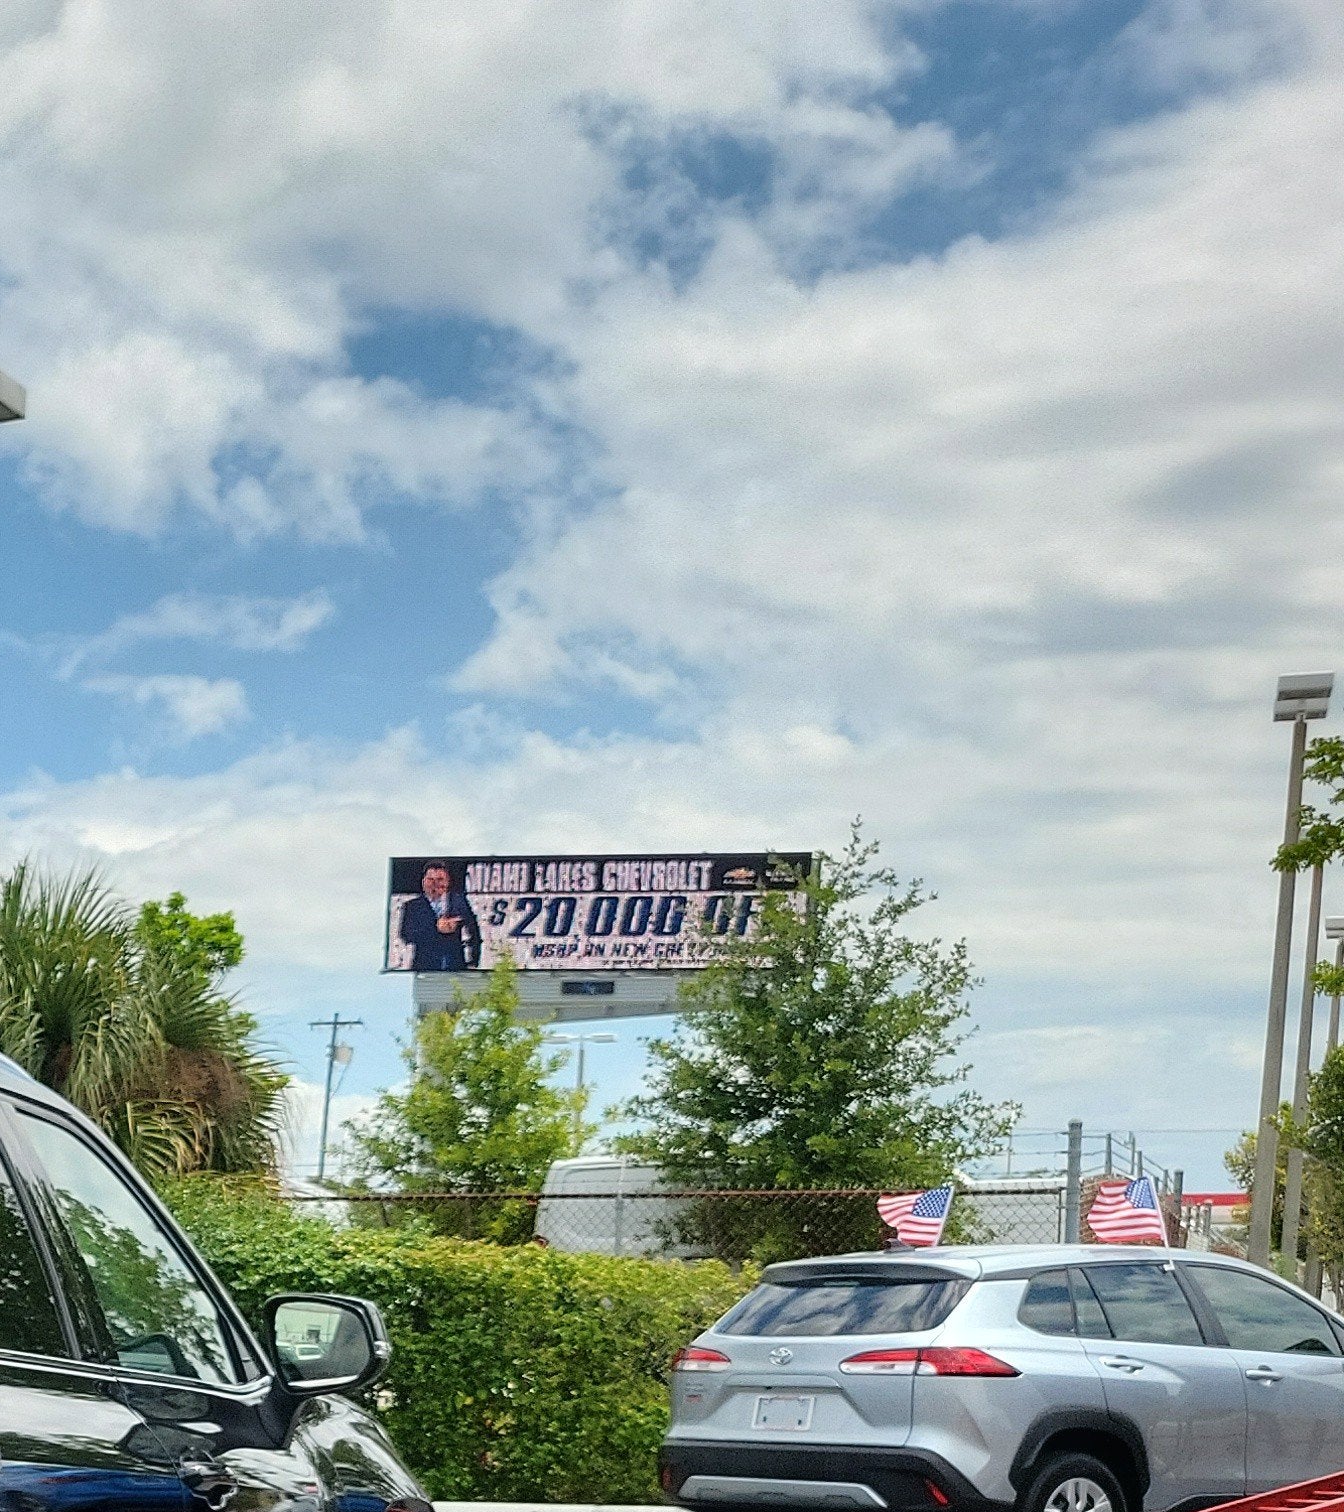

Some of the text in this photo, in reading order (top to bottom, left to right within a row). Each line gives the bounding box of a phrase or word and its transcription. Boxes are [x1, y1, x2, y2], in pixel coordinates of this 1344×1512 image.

[466, 860, 712, 893] MIAMI LAKES CHEVROLET
[611, 942, 650, 958] NEW
